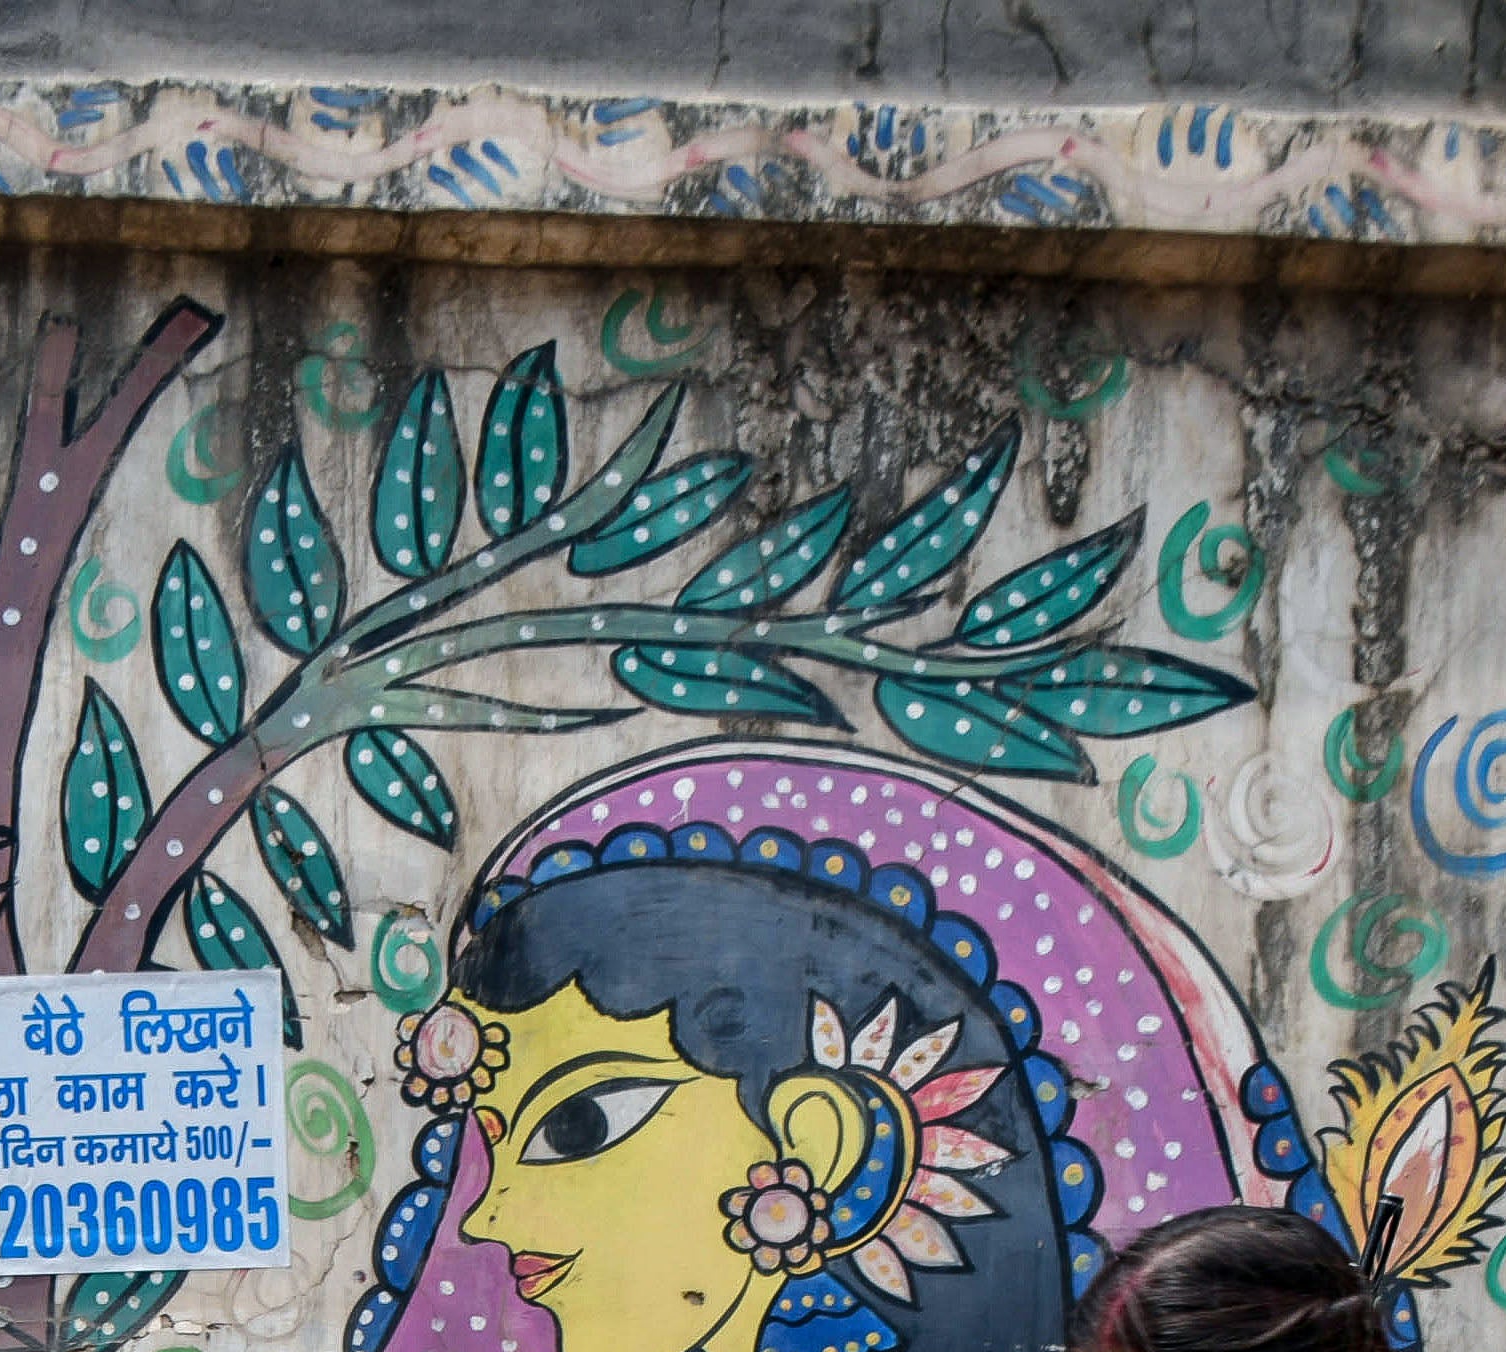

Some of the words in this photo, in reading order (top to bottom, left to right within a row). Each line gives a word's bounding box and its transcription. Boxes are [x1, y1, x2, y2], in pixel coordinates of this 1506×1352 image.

[22, 992, 85, 1057] बैठे
[120, 987, 255, 1054] लिखने
[55, 1072, 147, 1113] काम
[172, 1053, 242, 1110] करे
[72, 1120, 179, 1166] कमाये
[186, 1121, 272, 1169] 500/-
